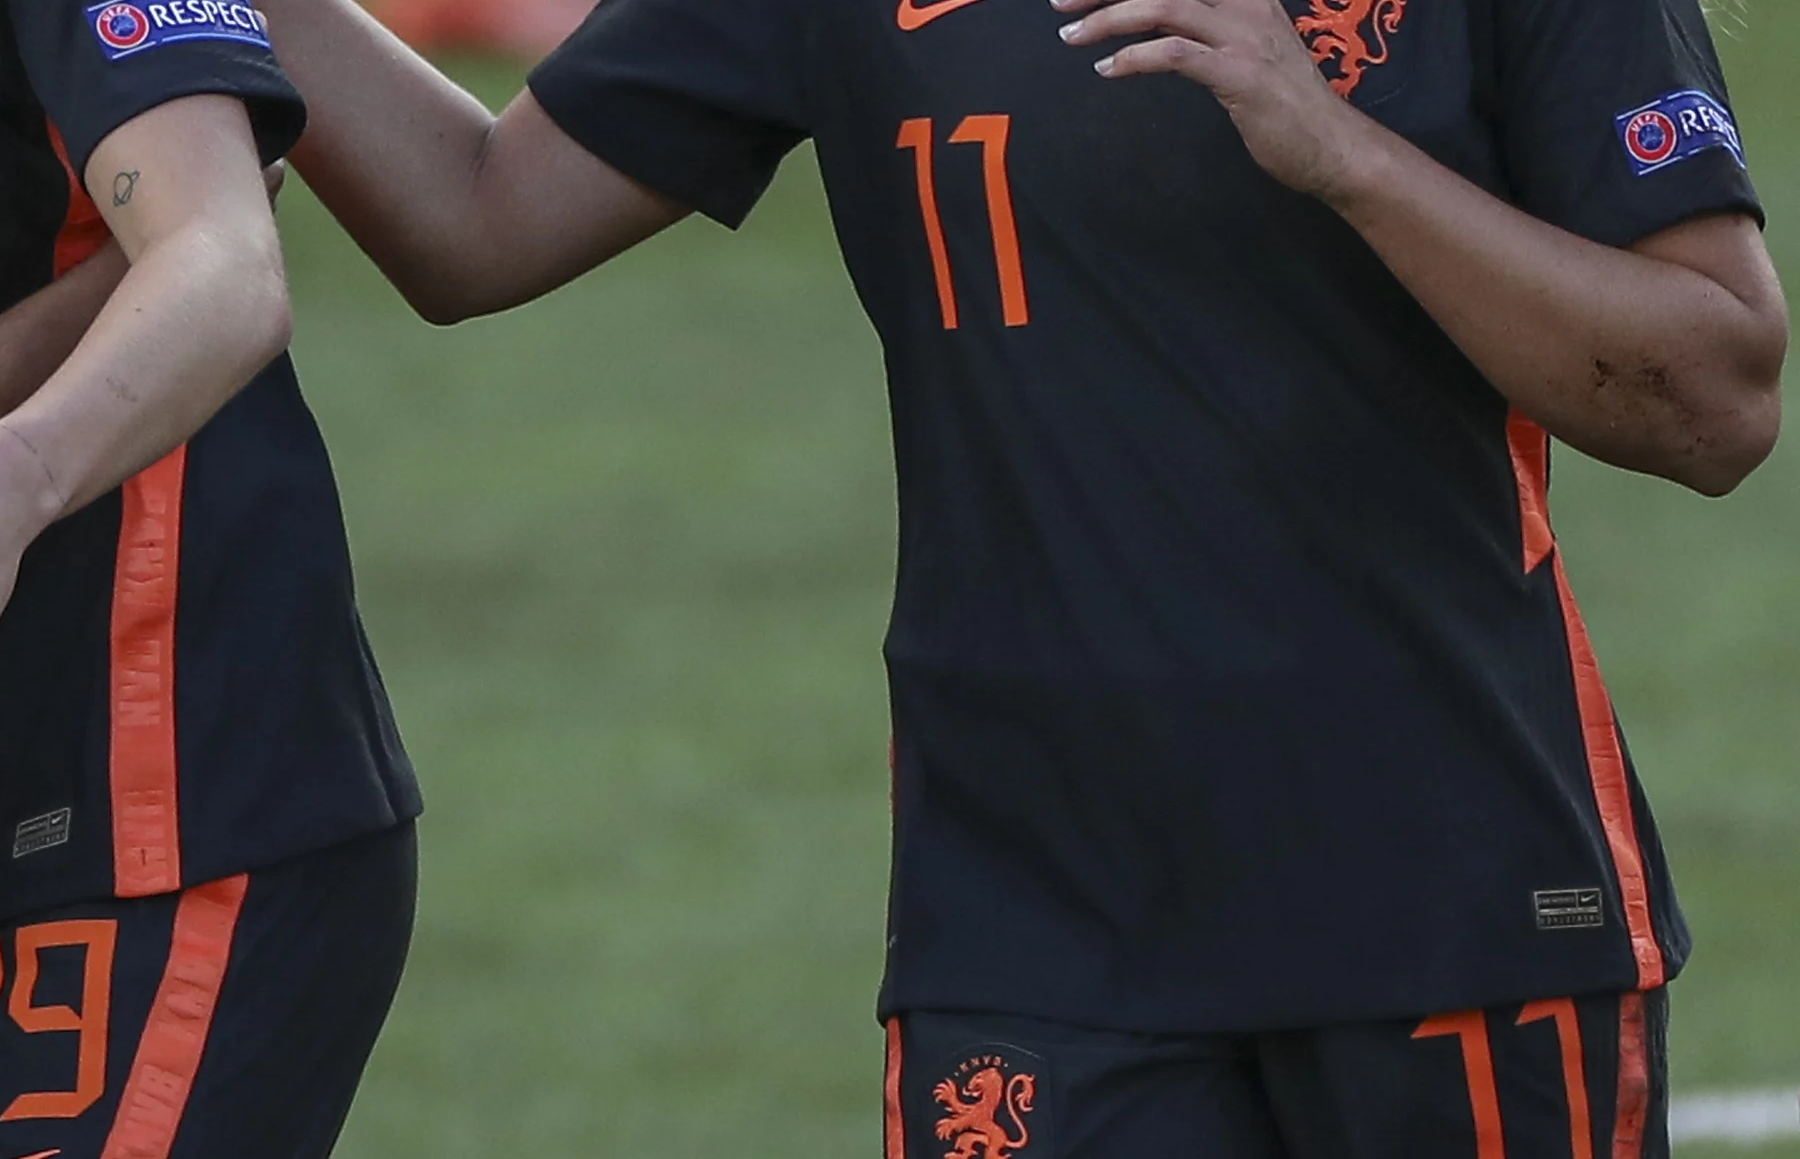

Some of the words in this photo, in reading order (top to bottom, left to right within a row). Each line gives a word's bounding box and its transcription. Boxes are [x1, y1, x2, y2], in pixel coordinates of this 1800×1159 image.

[101, 5, 132, 23] UEFA
[895, 114, 1029, 330] 11
[1410, 996, 1595, 1159] 11
